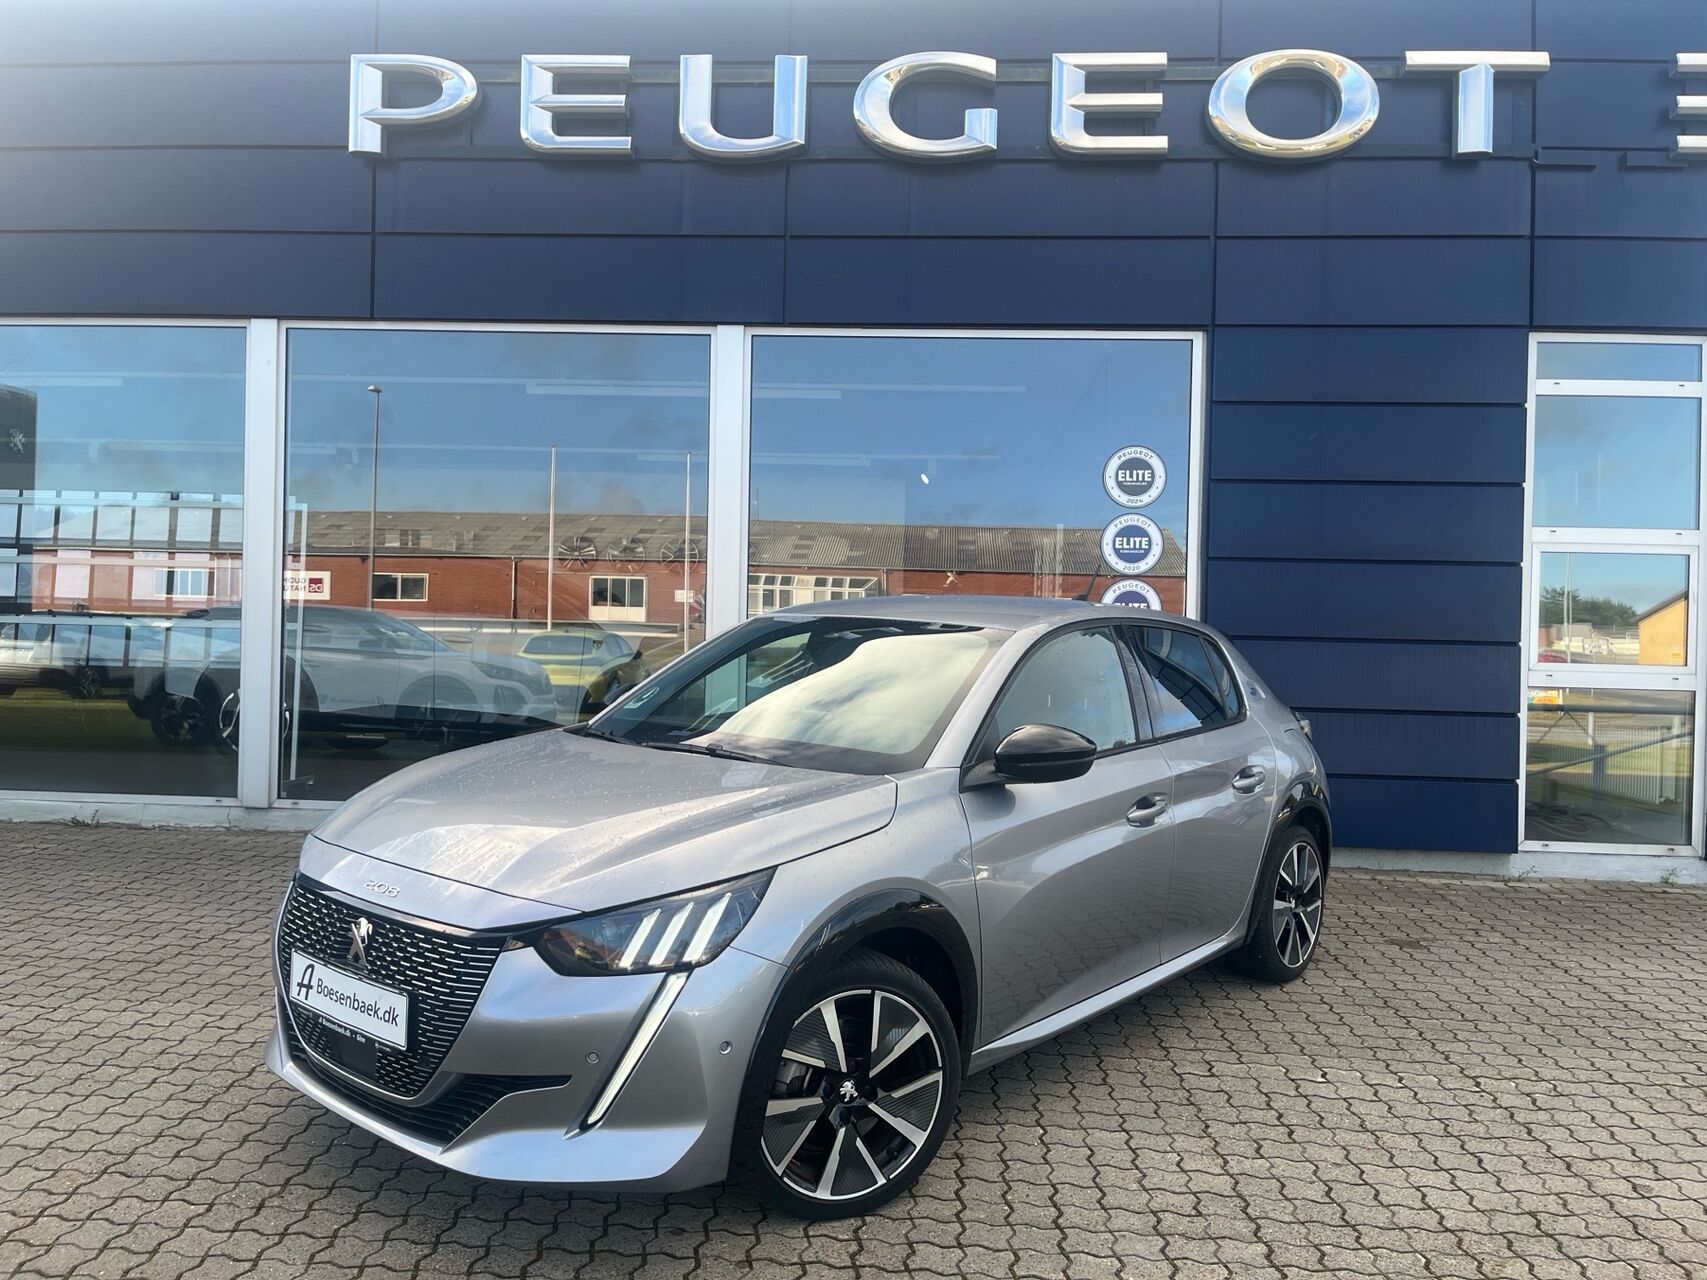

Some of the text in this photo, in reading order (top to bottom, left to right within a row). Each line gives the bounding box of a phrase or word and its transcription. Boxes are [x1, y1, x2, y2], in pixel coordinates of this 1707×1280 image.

[348, 49, 1550, 161] PEUGEOT
[1117, 449, 1154, 460] PEUGEOT
[1118, 470, 1152, 481] ELITE
[1113, 517, 1152, 529] PEUGEOT
[1115, 537, 1149, 549] ELITE
[1112, 582, 1150, 595] PEUGEOT
[363, 879, 400, 899] 208
[316, 977, 400, 1027] Boesenbaek.dk
